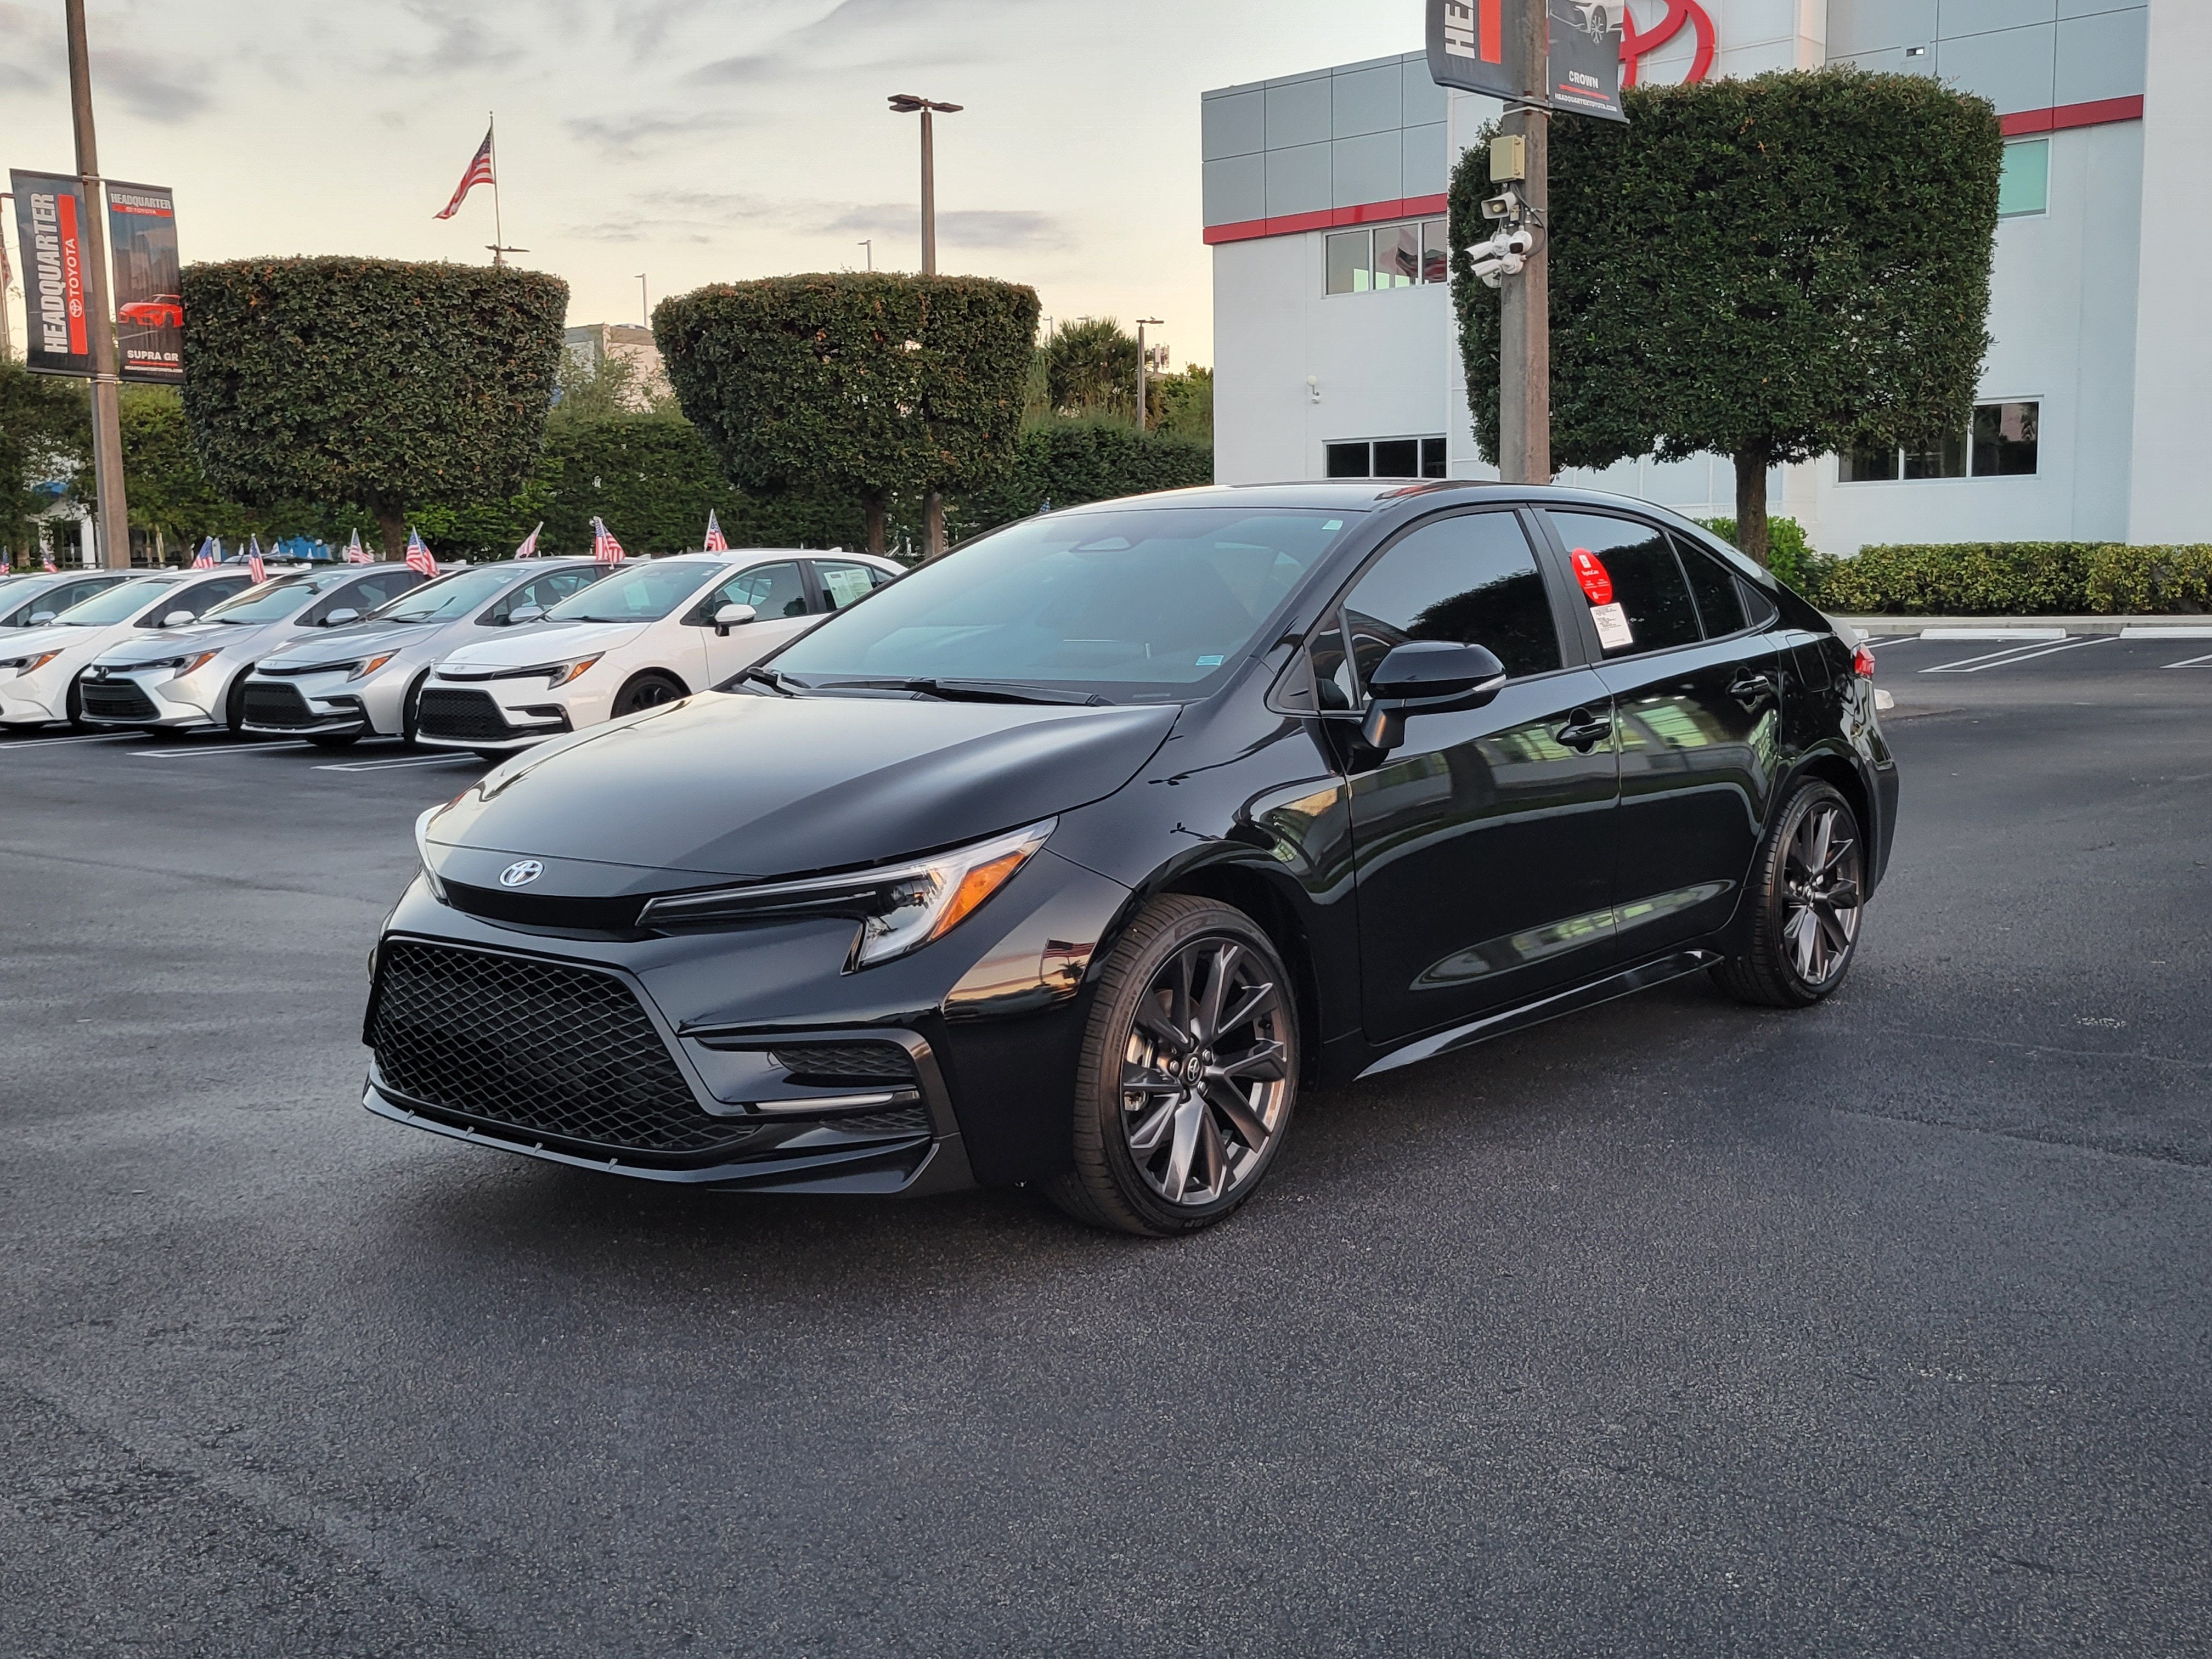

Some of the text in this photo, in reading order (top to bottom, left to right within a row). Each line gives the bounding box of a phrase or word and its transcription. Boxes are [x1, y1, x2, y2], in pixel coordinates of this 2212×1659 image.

[1568, 70, 1599, 89] CROWN
[110, 193, 172, 210] HEADQUARTER
[31, 193, 68, 353] HEADQUARTER
[65, 238, 80, 297] TOYOTA
[127, 350, 179, 362] SUPRA GR
